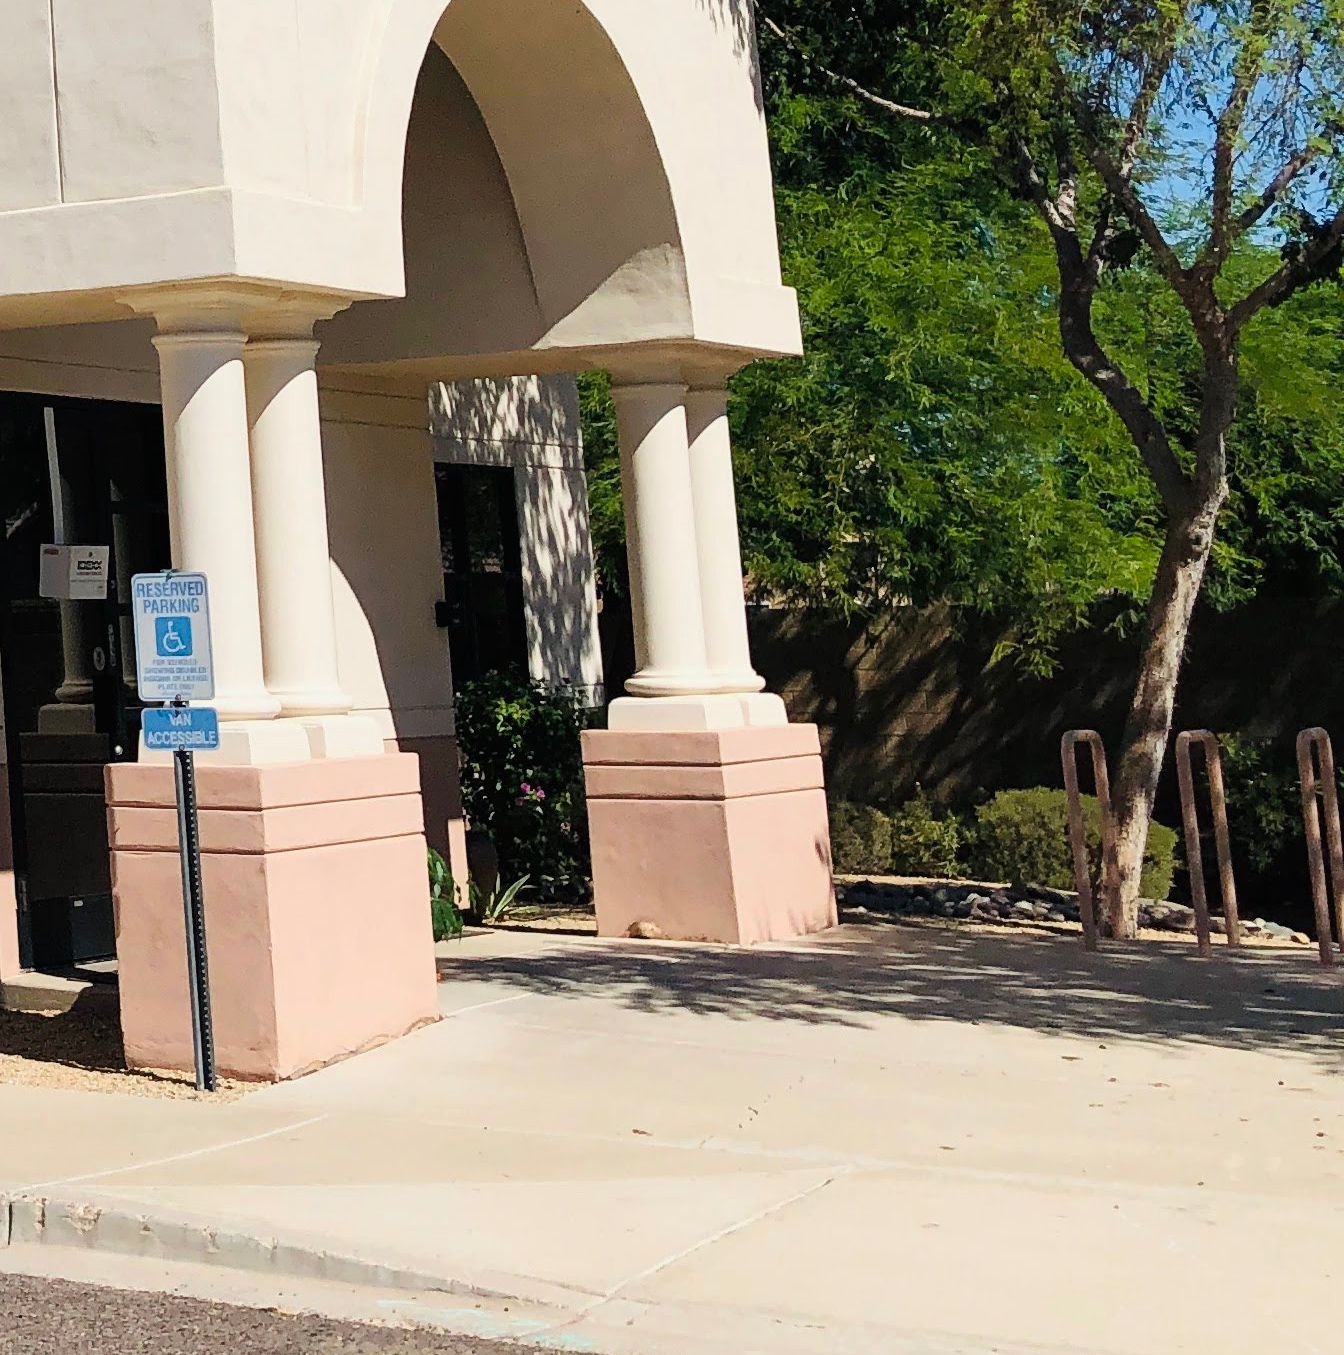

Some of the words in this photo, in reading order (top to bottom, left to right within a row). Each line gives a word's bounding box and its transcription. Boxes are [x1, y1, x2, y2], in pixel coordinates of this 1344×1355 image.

[135, 581, 204, 597] RESERVED
[143, 598, 200, 613] PARKING
[168, 712, 192, 726] VAN
[147, 730, 217, 744] ACCESSIBLE
